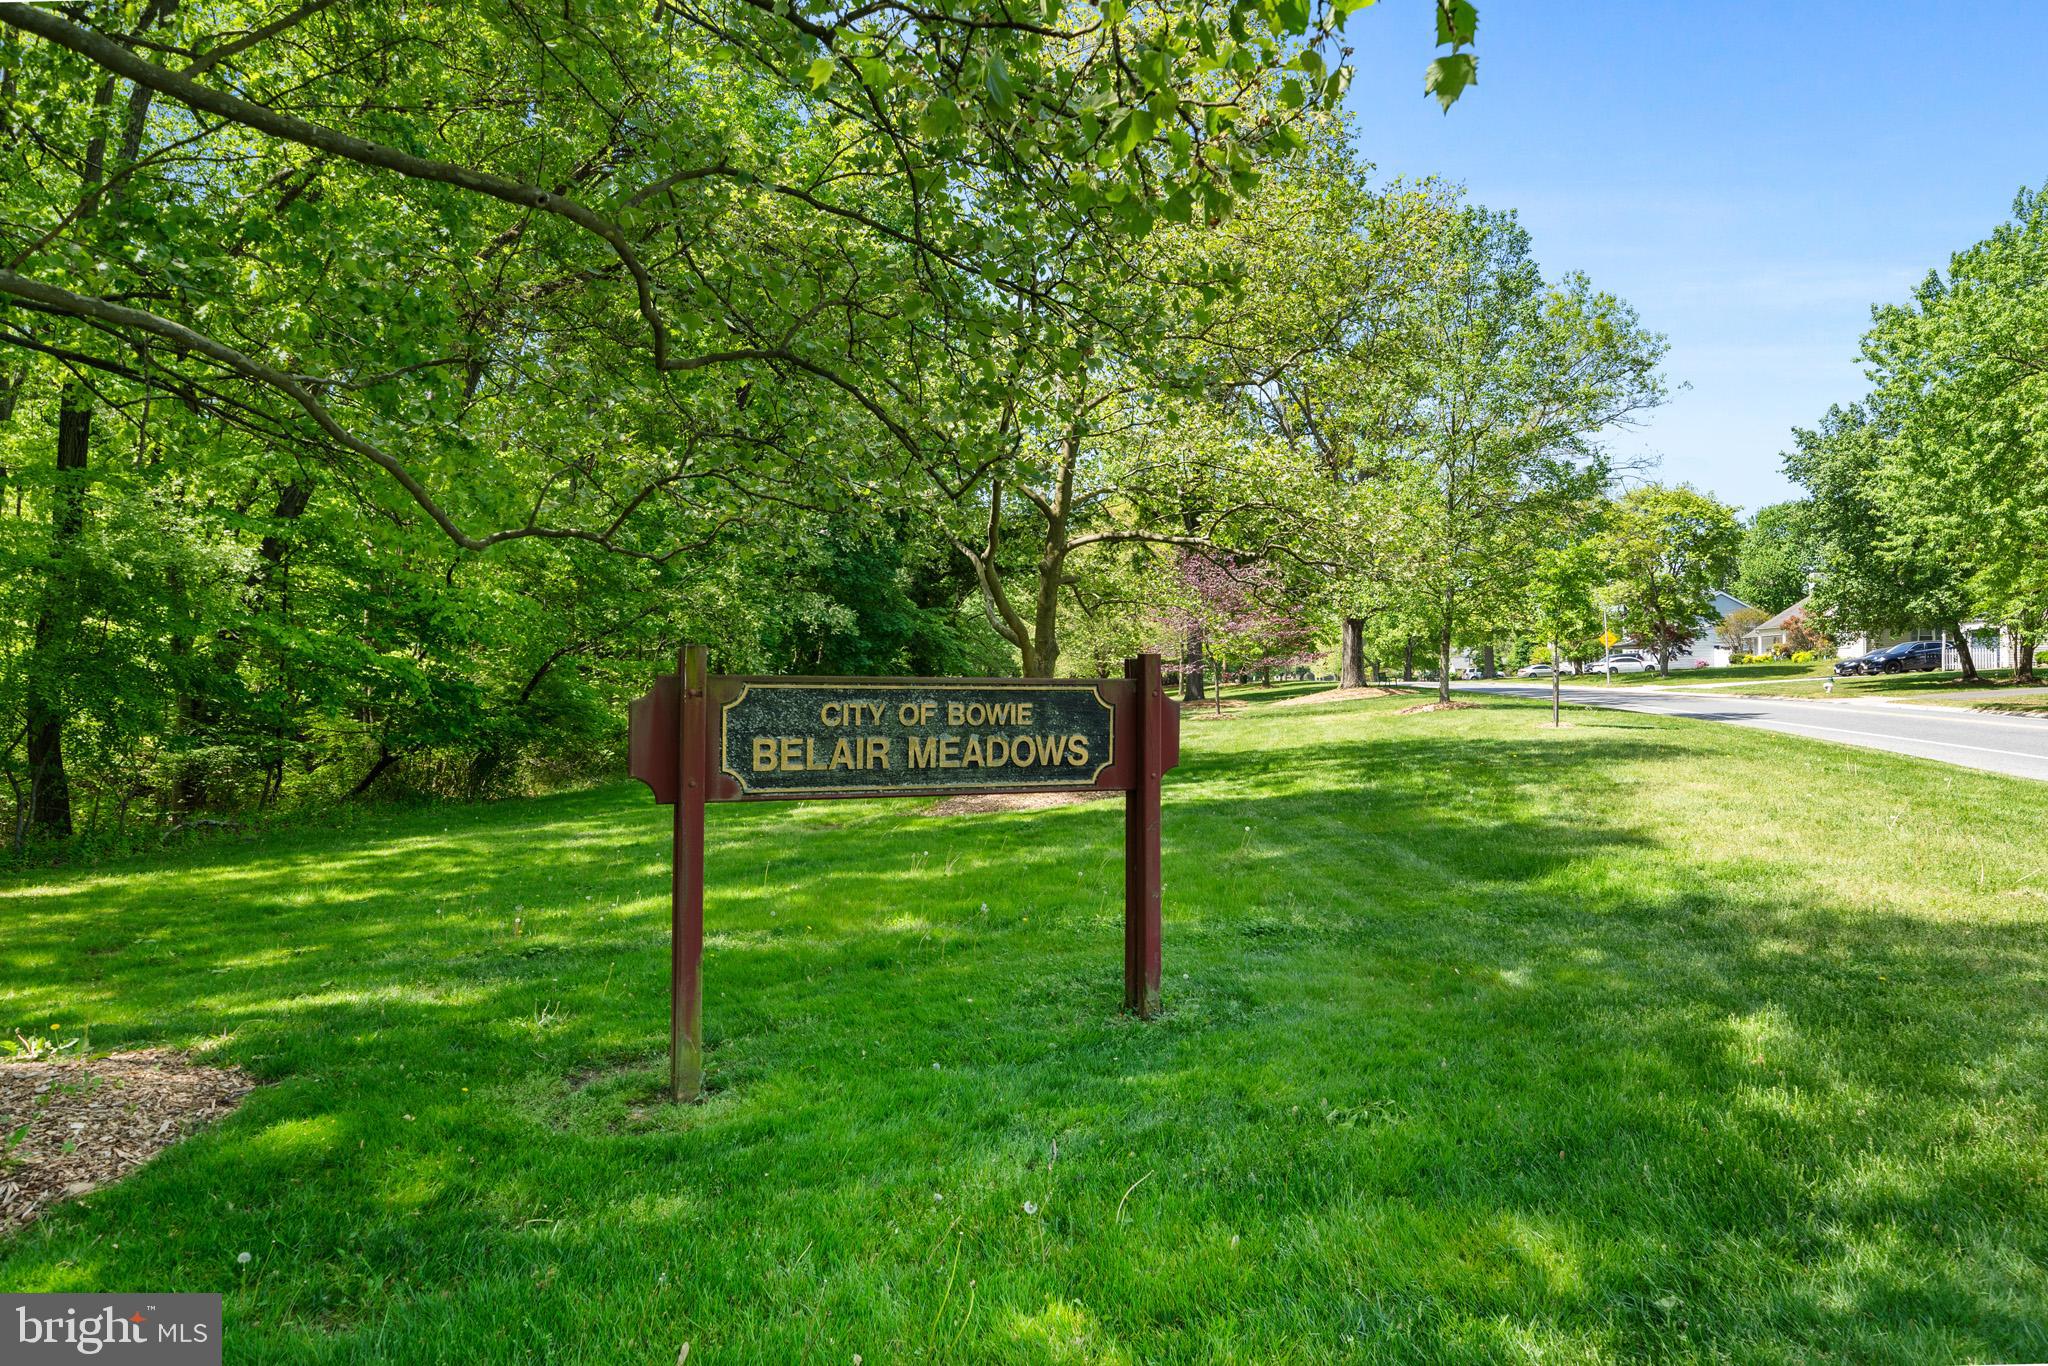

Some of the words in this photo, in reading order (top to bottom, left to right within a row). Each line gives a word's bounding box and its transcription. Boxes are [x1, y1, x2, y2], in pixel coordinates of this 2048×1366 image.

[820, 702, 886, 727] CITY
[898, 702, 936, 727] OF
[947, 702, 1034, 726] BOWIE
[752, 736, 891, 772] BELAIR
[907, 734, 1090, 769] MEADOWS
